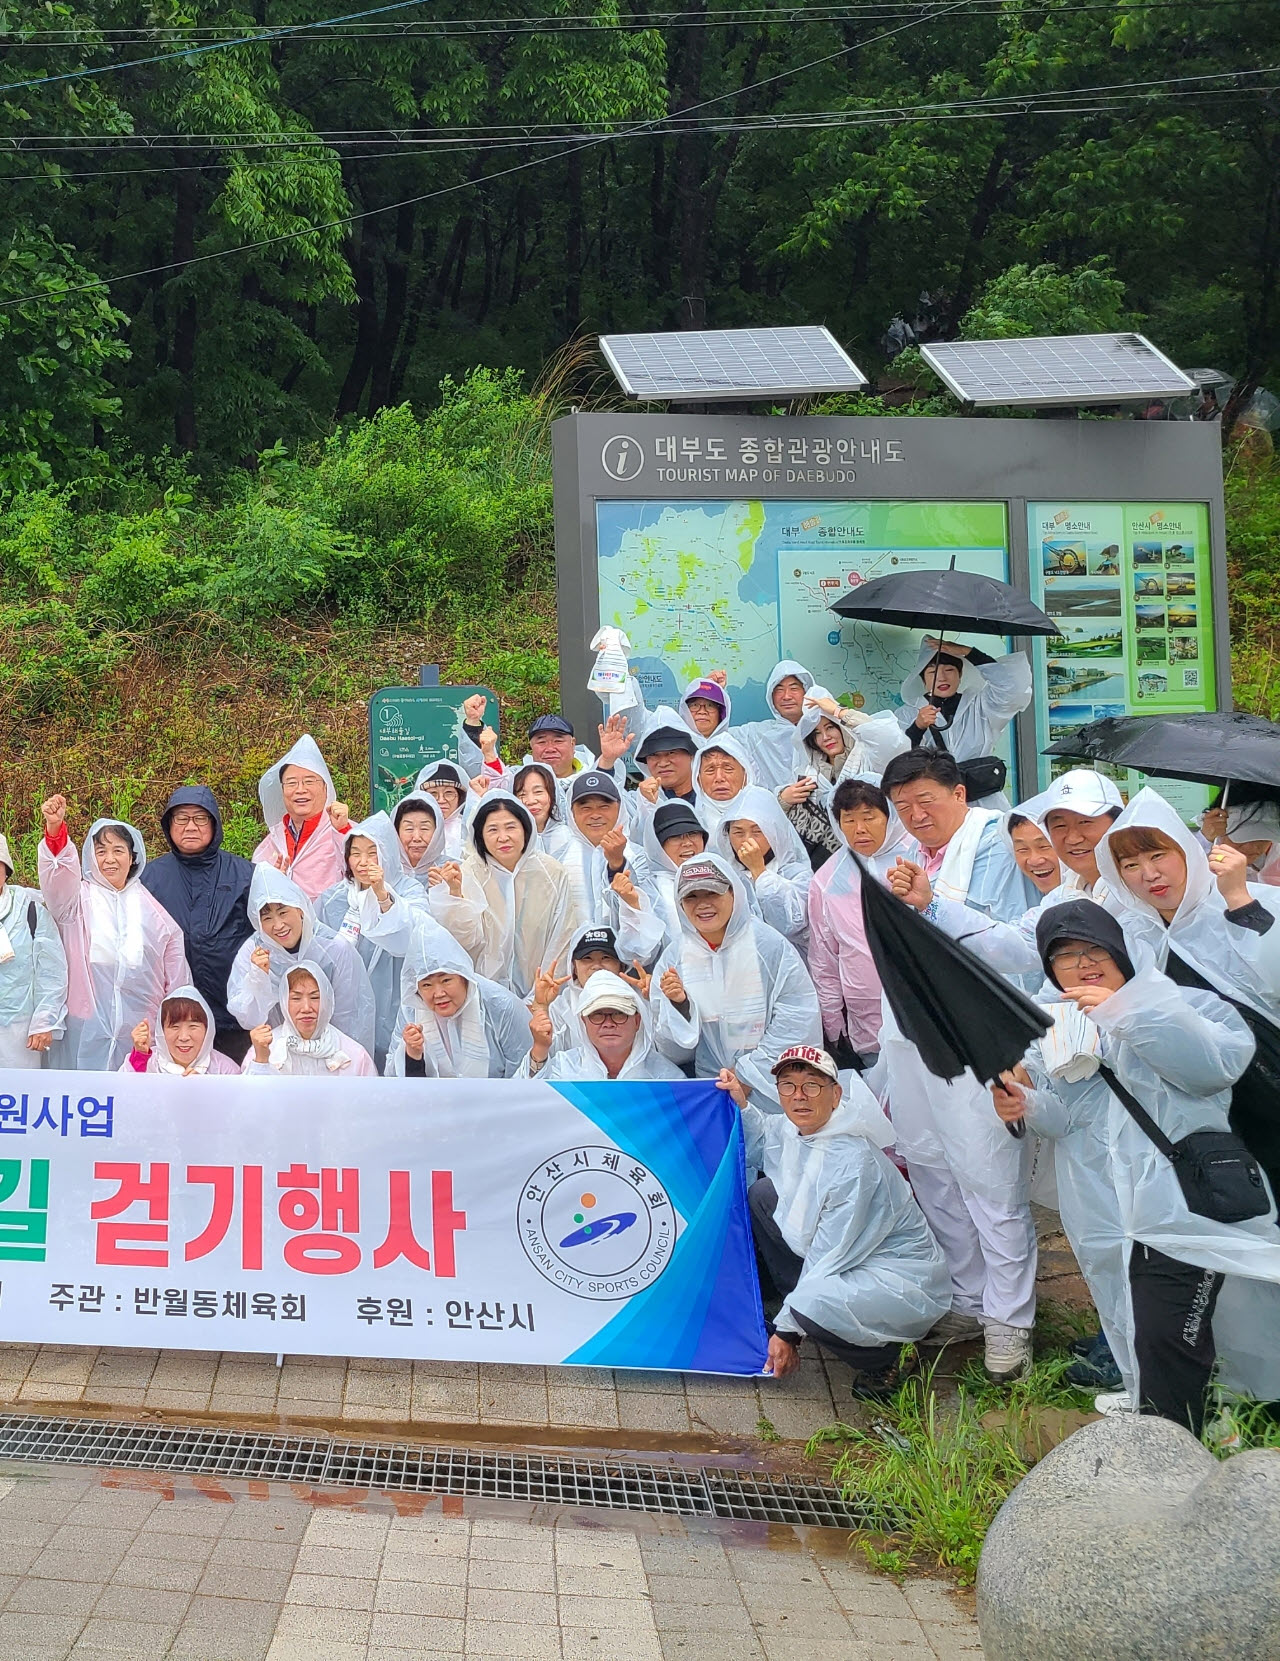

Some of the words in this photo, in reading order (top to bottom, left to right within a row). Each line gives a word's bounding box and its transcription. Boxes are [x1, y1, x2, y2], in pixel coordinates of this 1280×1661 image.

[655, 436, 728, 463] 대부도
[738, 437, 906, 465] 종합관광안내도
[656, 468, 720, 482] TOURIST
[725, 468, 758, 482] MAP
[762, 469, 781, 482] OF
[786, 469, 856, 483] DAEBUDO
[781, 527, 801, 537] 대부
[818, 526, 865, 538] 종합안내도
[526, 1151, 667, 1209] 안산시체육회
[90, 1161, 466, 1278] 걷기행사
[526, 1228, 554, 1270] ANSAN
[554, 1269, 584, 1289] CITY
[588, 1276, 638, 1293] SPORTS
[639, 1228, 670, 1280] COUNCIL
[48, 1284, 105, 1313] 주관
[133, 1285, 307, 1323] 반월동체육회
[355, 1296, 414, 1328] 후원
[446, 1299, 536, 1332] 안산시
